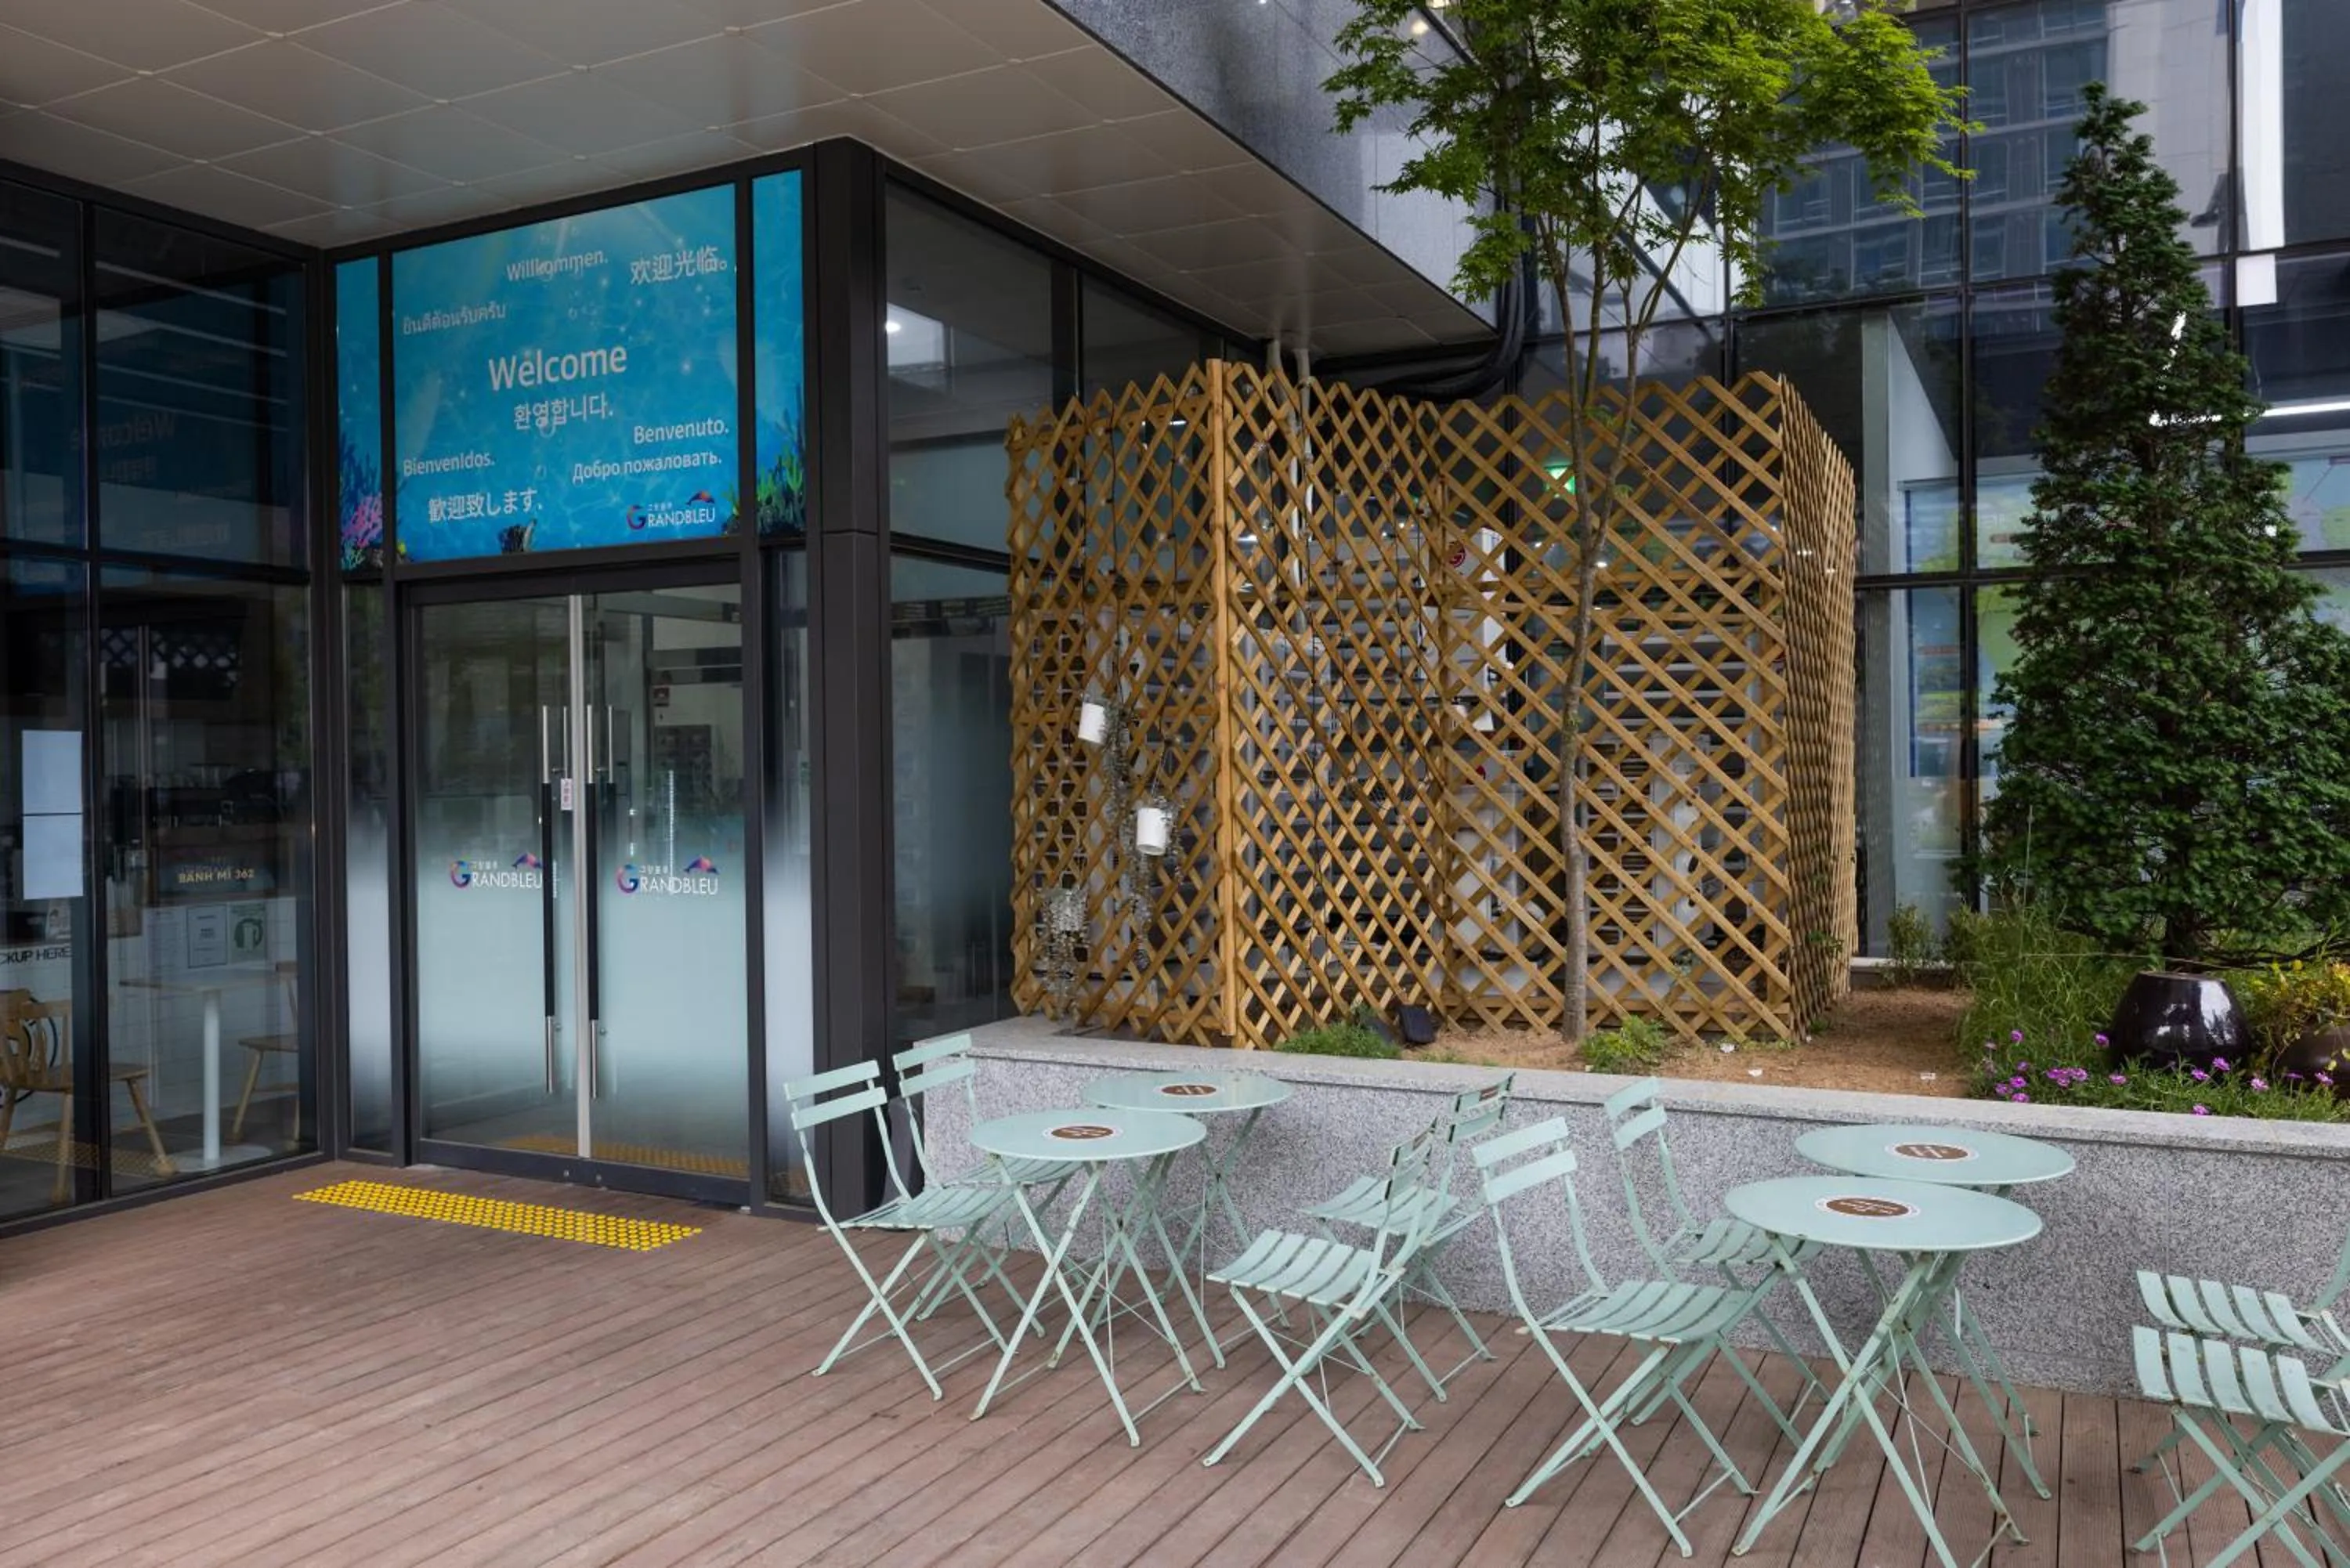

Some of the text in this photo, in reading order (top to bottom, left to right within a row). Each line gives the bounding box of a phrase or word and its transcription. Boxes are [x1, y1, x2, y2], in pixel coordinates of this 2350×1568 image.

[506, 250, 609, 282] Willkommen.
[630, 245, 728, 285] 欢迎光临。
[488, 345, 627, 392] Welcome
[514, 391, 613, 430] 환영합니다.
[633, 417, 729, 445] Benvenuto.
[403, 449, 496, 477] Bienvenidos.
[572, 451, 722, 486] Добро пожаловать.
[627, 504, 716, 530] GRANDBLEU
[450, 859, 543, 889] GRANDBLEU
[616, 864, 718, 895] GRANDBLEU
